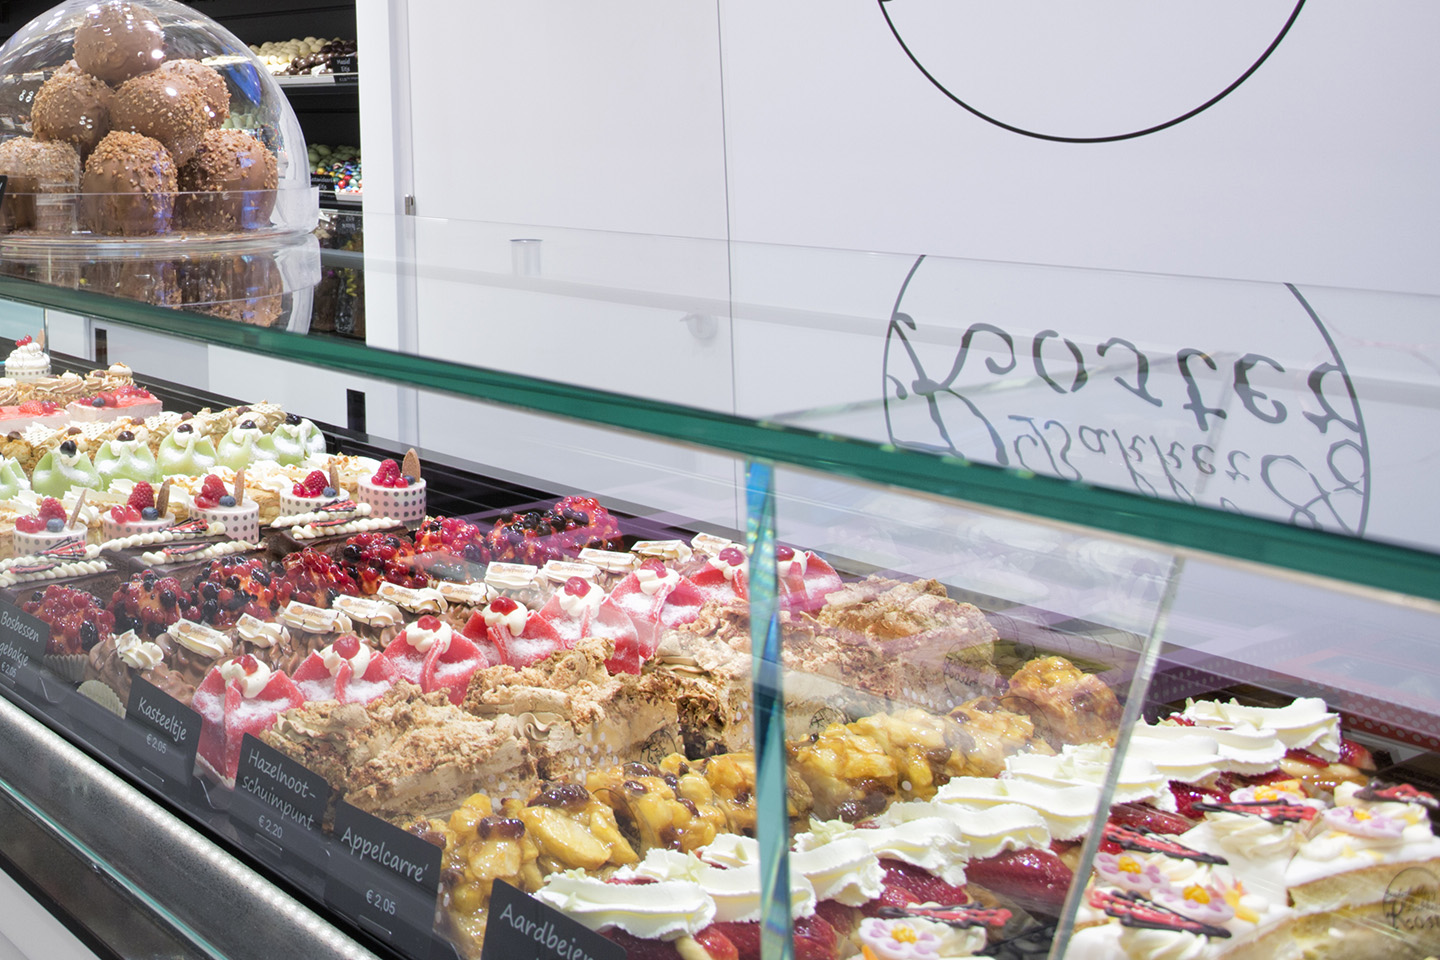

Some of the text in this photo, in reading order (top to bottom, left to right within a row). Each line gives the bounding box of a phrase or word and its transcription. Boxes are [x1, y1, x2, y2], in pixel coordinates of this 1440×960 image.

[0, 611, 39, 642] Bosbessen
[138, 696, 187, 742] Kasteeltje
[248, 748, 316, 798] Hazelnoot-
[242, 776, 314, 831] schuimpunt
